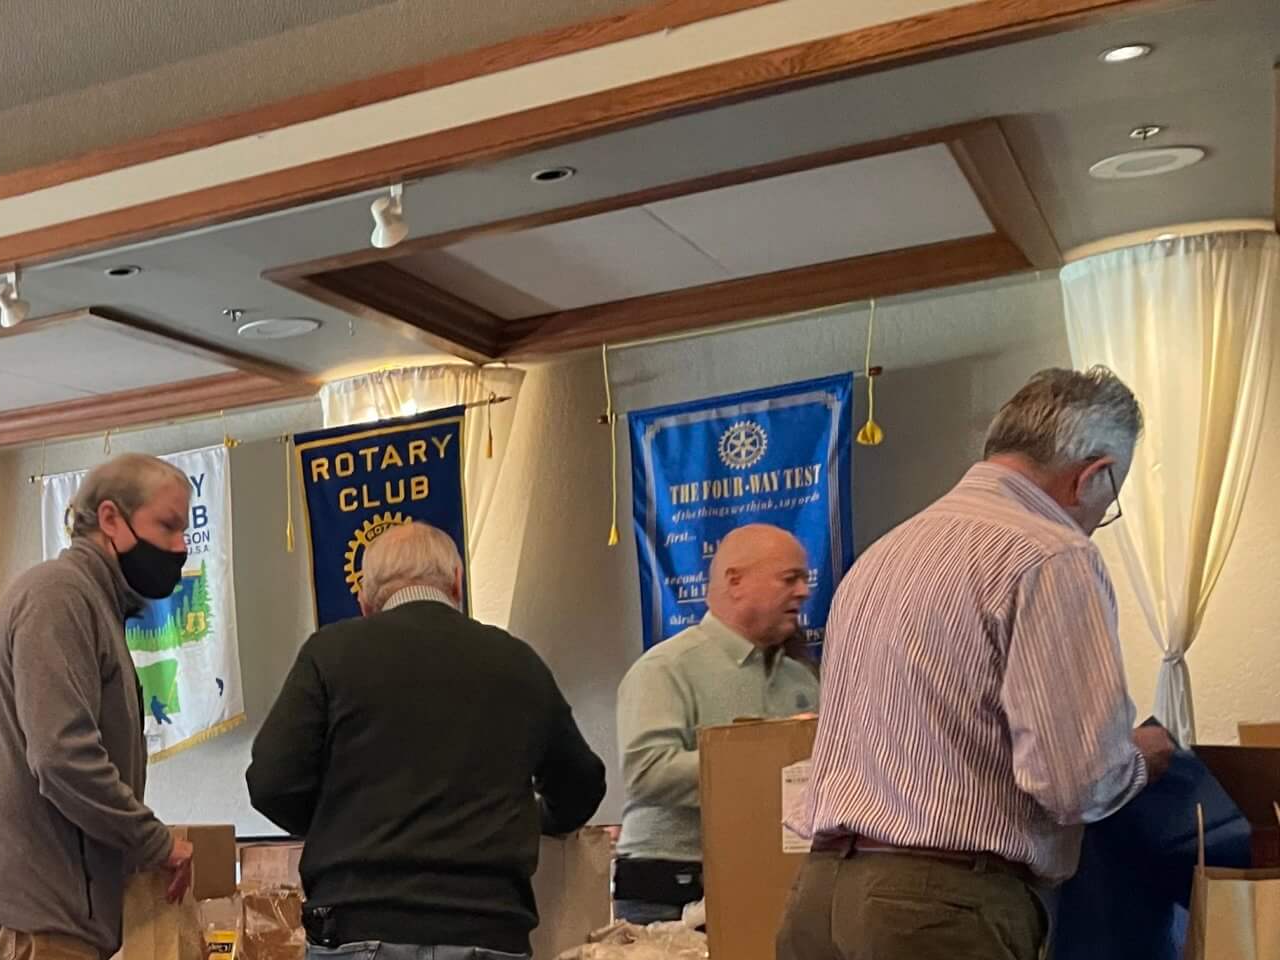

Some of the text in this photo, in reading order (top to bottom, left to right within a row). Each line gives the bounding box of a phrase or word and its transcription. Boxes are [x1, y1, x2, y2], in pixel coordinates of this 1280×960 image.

[310, 433, 453, 483] ROTARY
[339, 475, 430, 512] CLUB
[670, 481, 699, 504] THE
[784, 464, 822, 490] TEST
